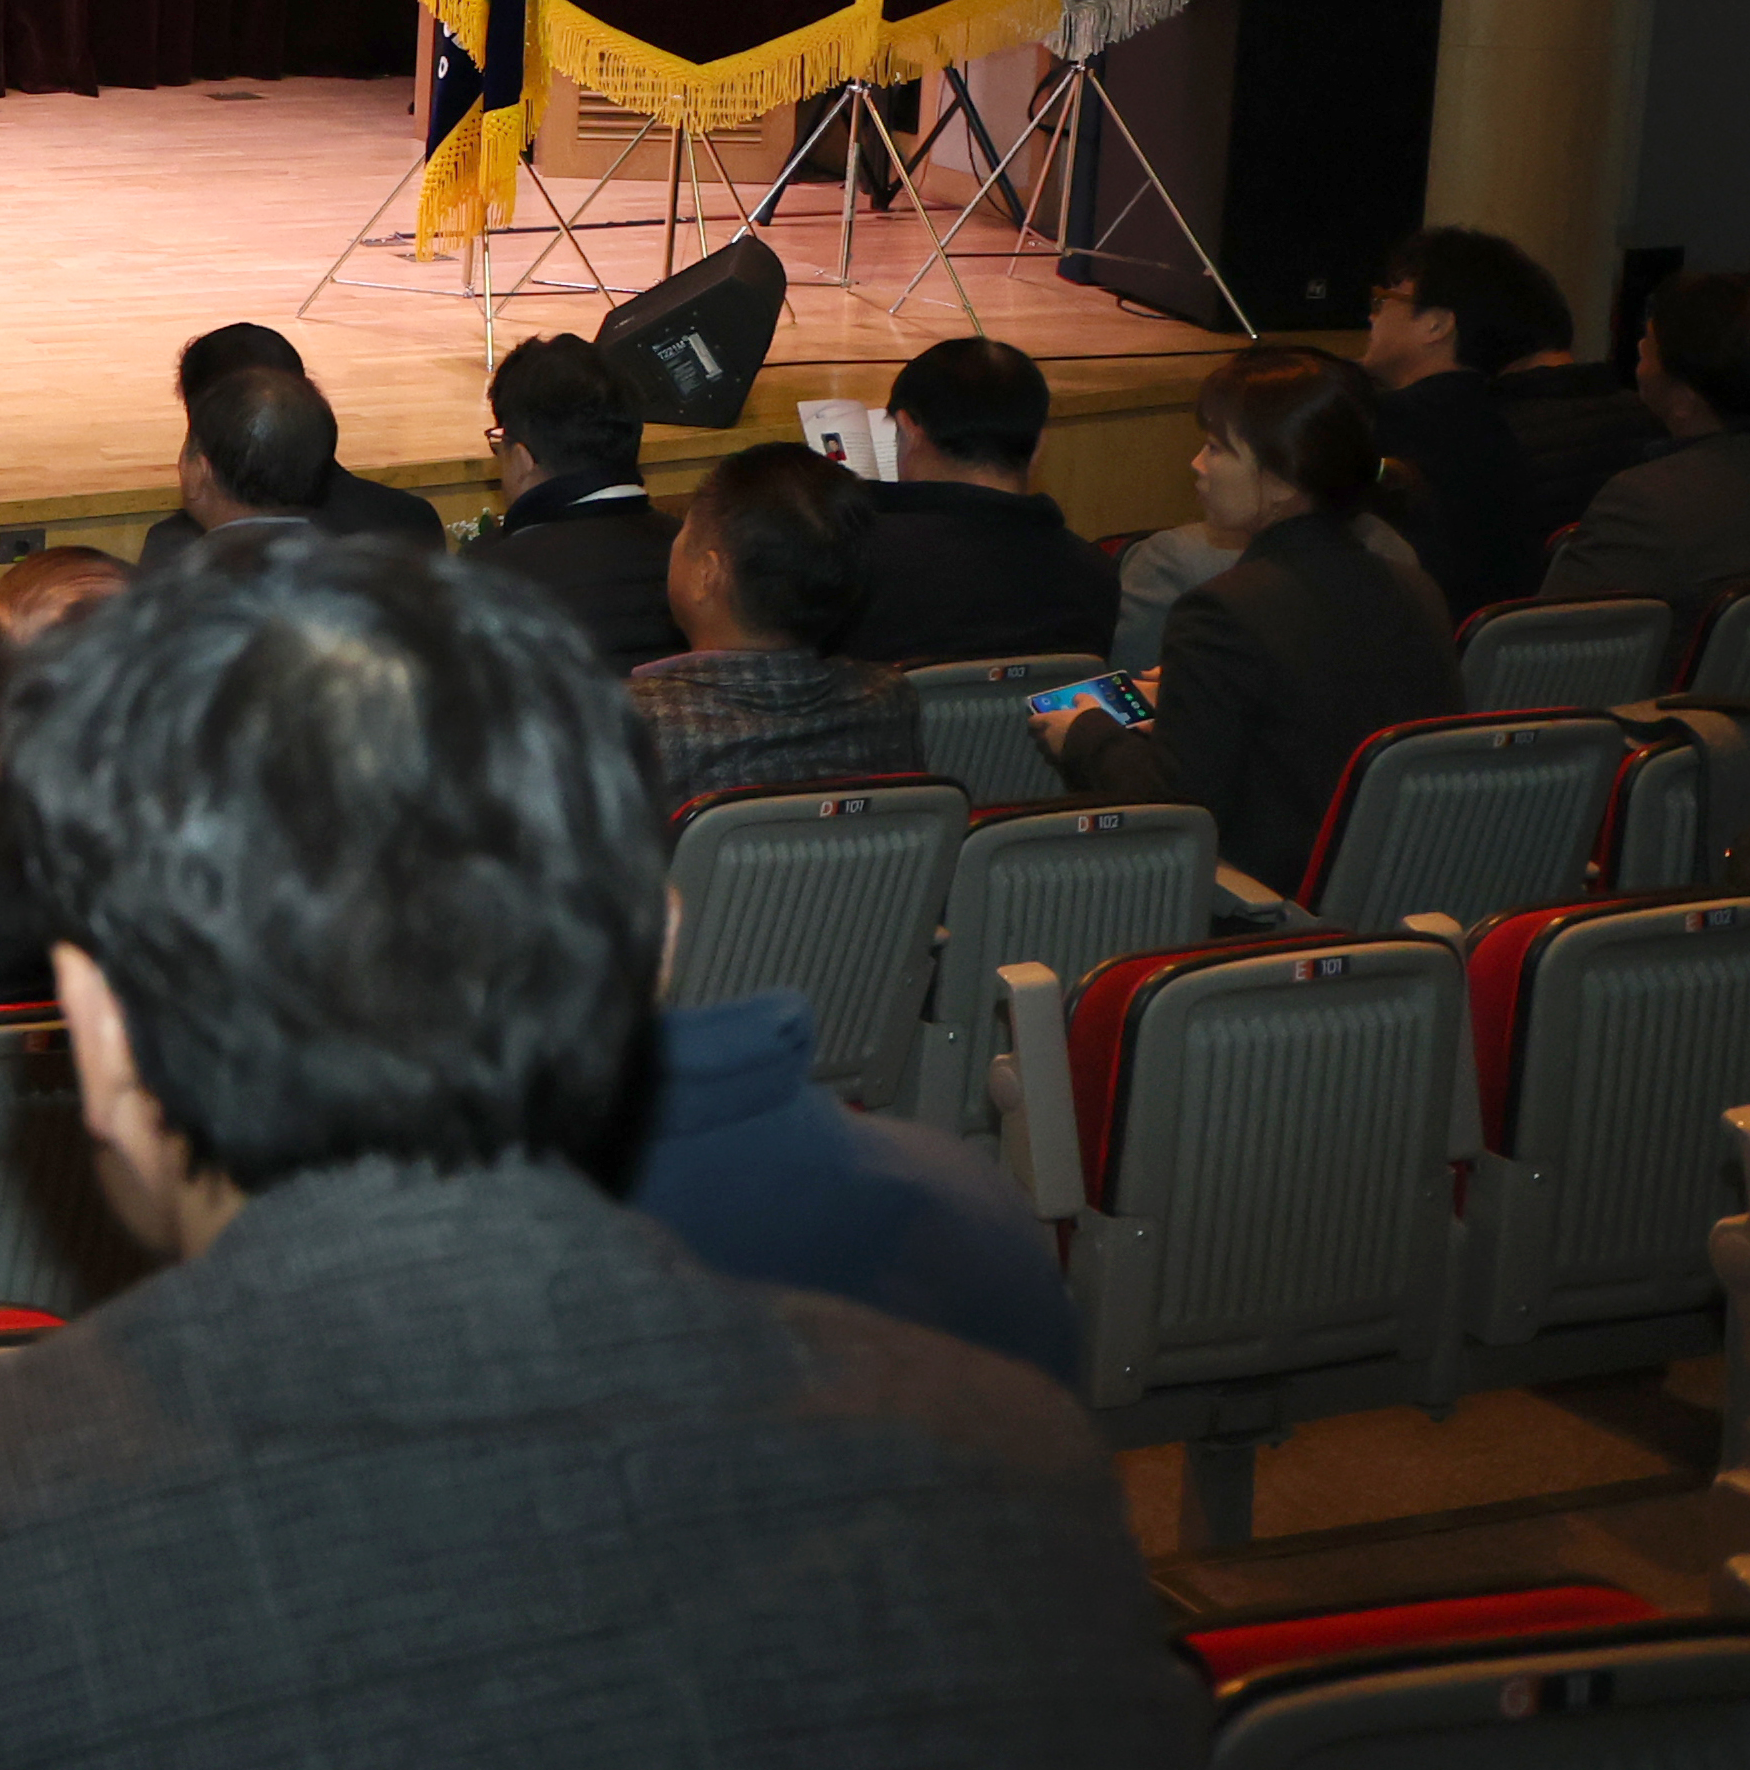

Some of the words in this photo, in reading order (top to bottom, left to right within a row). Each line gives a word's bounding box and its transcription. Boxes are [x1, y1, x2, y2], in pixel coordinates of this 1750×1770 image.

[819, 800, 833, 818] D
[1078, 816, 1089, 832] D
[1099, 815, 1119, 829] 102
[1295, 960, 1307, 980] E
[1321, 958, 1342, 975] 101
